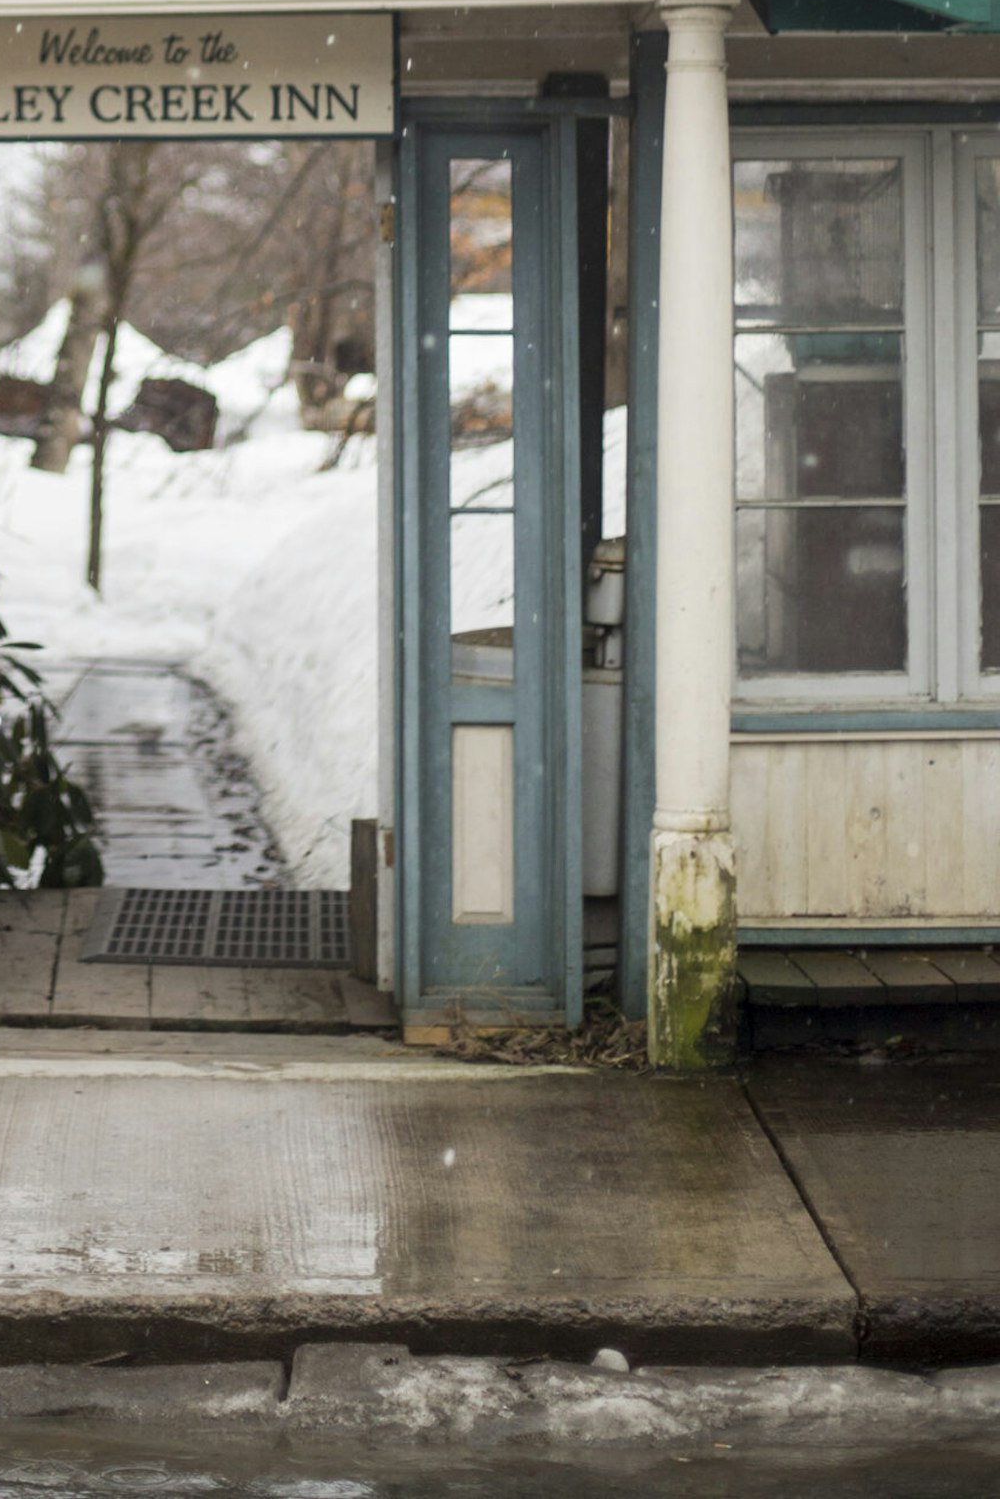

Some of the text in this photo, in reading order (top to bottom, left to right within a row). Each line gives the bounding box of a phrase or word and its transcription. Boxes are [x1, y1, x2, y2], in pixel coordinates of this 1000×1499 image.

[38, 27, 238, 65] Welcome to the
[89, 84, 253, 122] CREEK
[270, 84, 360, 121] INN
